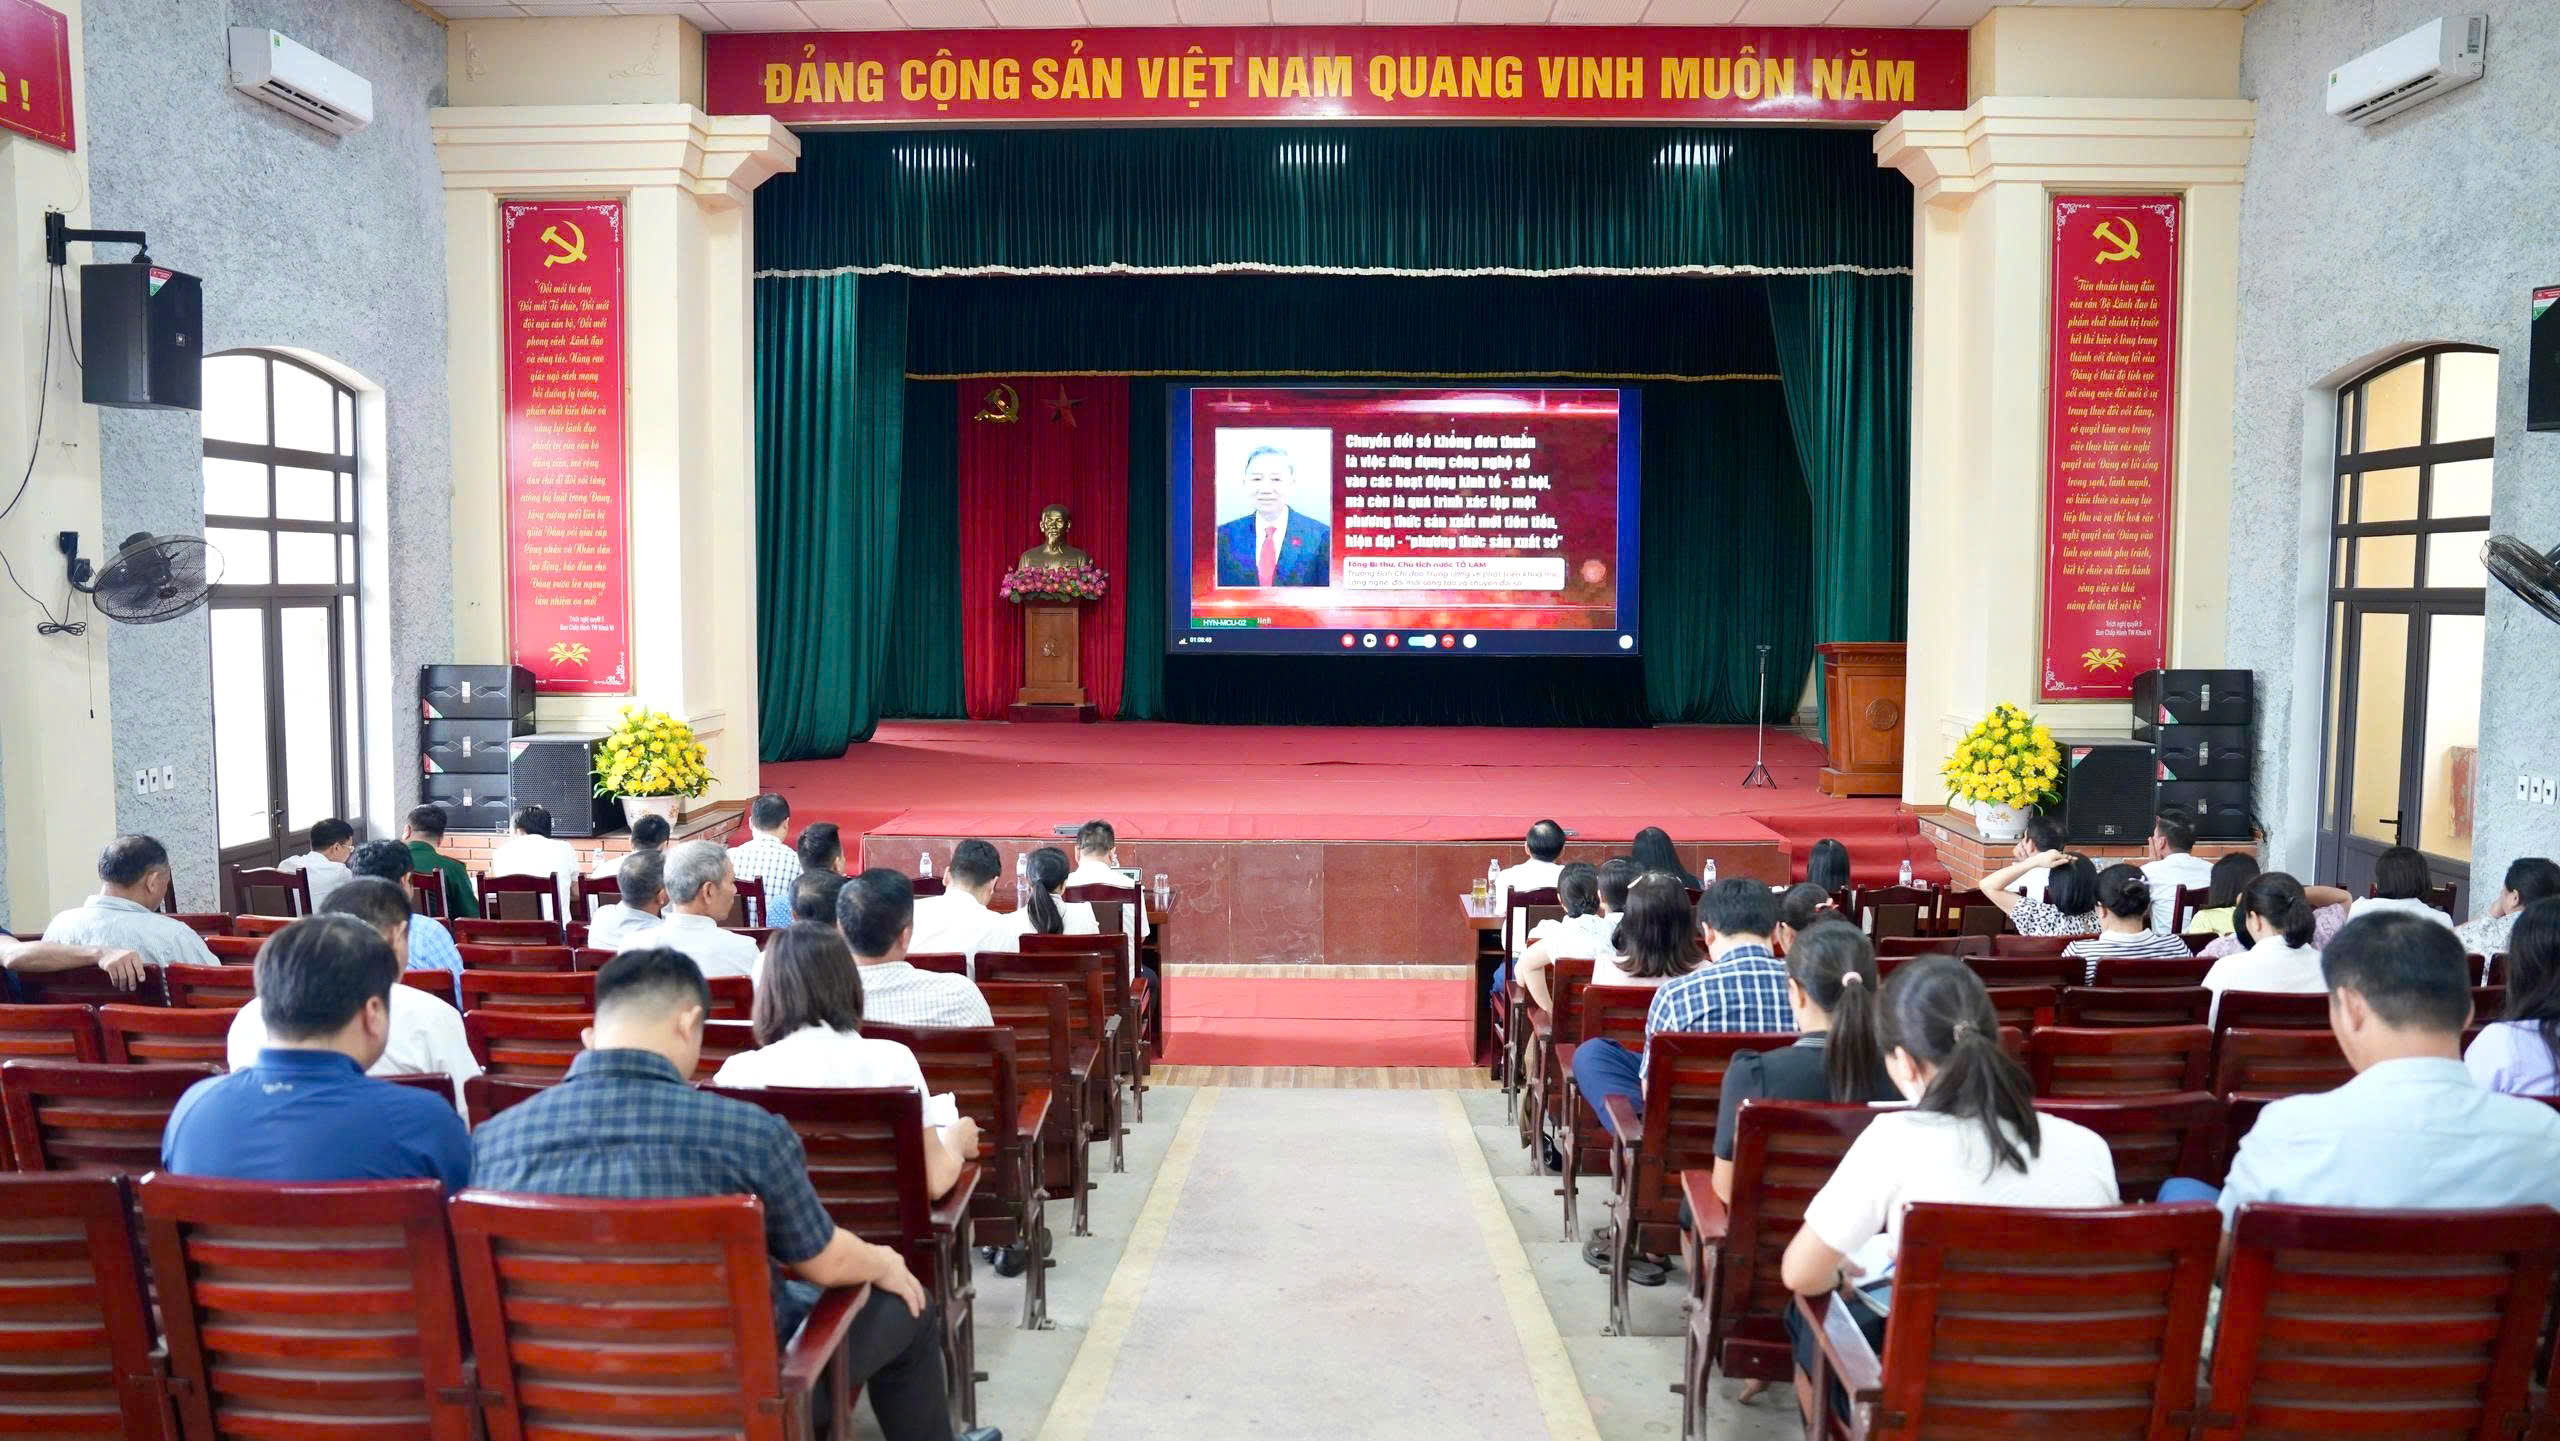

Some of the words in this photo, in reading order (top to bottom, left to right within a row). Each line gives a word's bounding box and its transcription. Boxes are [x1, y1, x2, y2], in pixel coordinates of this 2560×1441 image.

[765, 43, 884, 104] ĐẢNG
[900, 48, 1020, 111] CỘNG
[1031, 39, 1122, 100] SẢN
[1137, 46, 1233, 108] VIỆT
[1248, 57, 1353, 98] NAM
[1369, 55, 1523, 102] QUANG
[1537, 56, 1644, 99] VINH
[1660, 45, 1795, 100] MUÔN
[1812, 48, 1915, 102] NĂM
